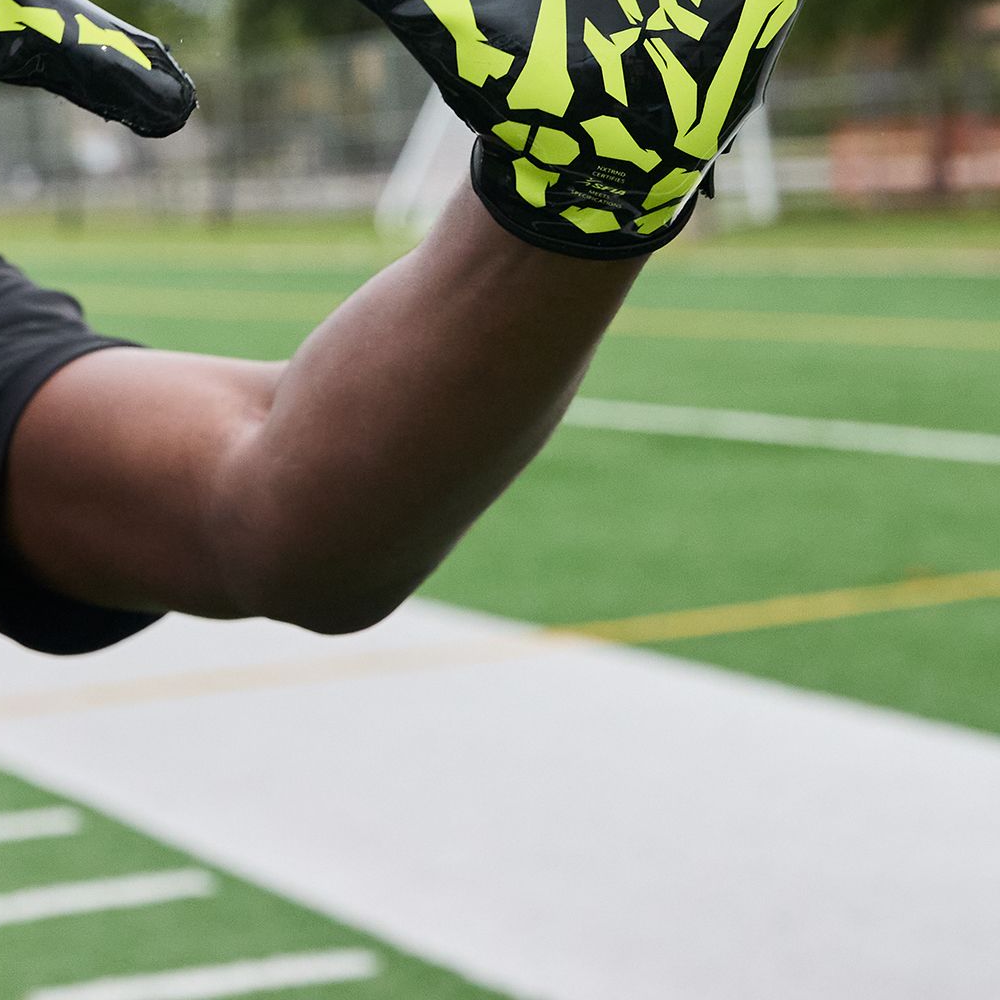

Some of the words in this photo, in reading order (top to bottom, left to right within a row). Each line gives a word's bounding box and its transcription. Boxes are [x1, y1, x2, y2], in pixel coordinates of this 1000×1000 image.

[596, 165, 626, 177] NXTRND
[592, 171, 625, 184] CERTIFIES
[570, 189, 622, 208] SPECIFICATIONS
[588, 189, 610, 199] MEETS
